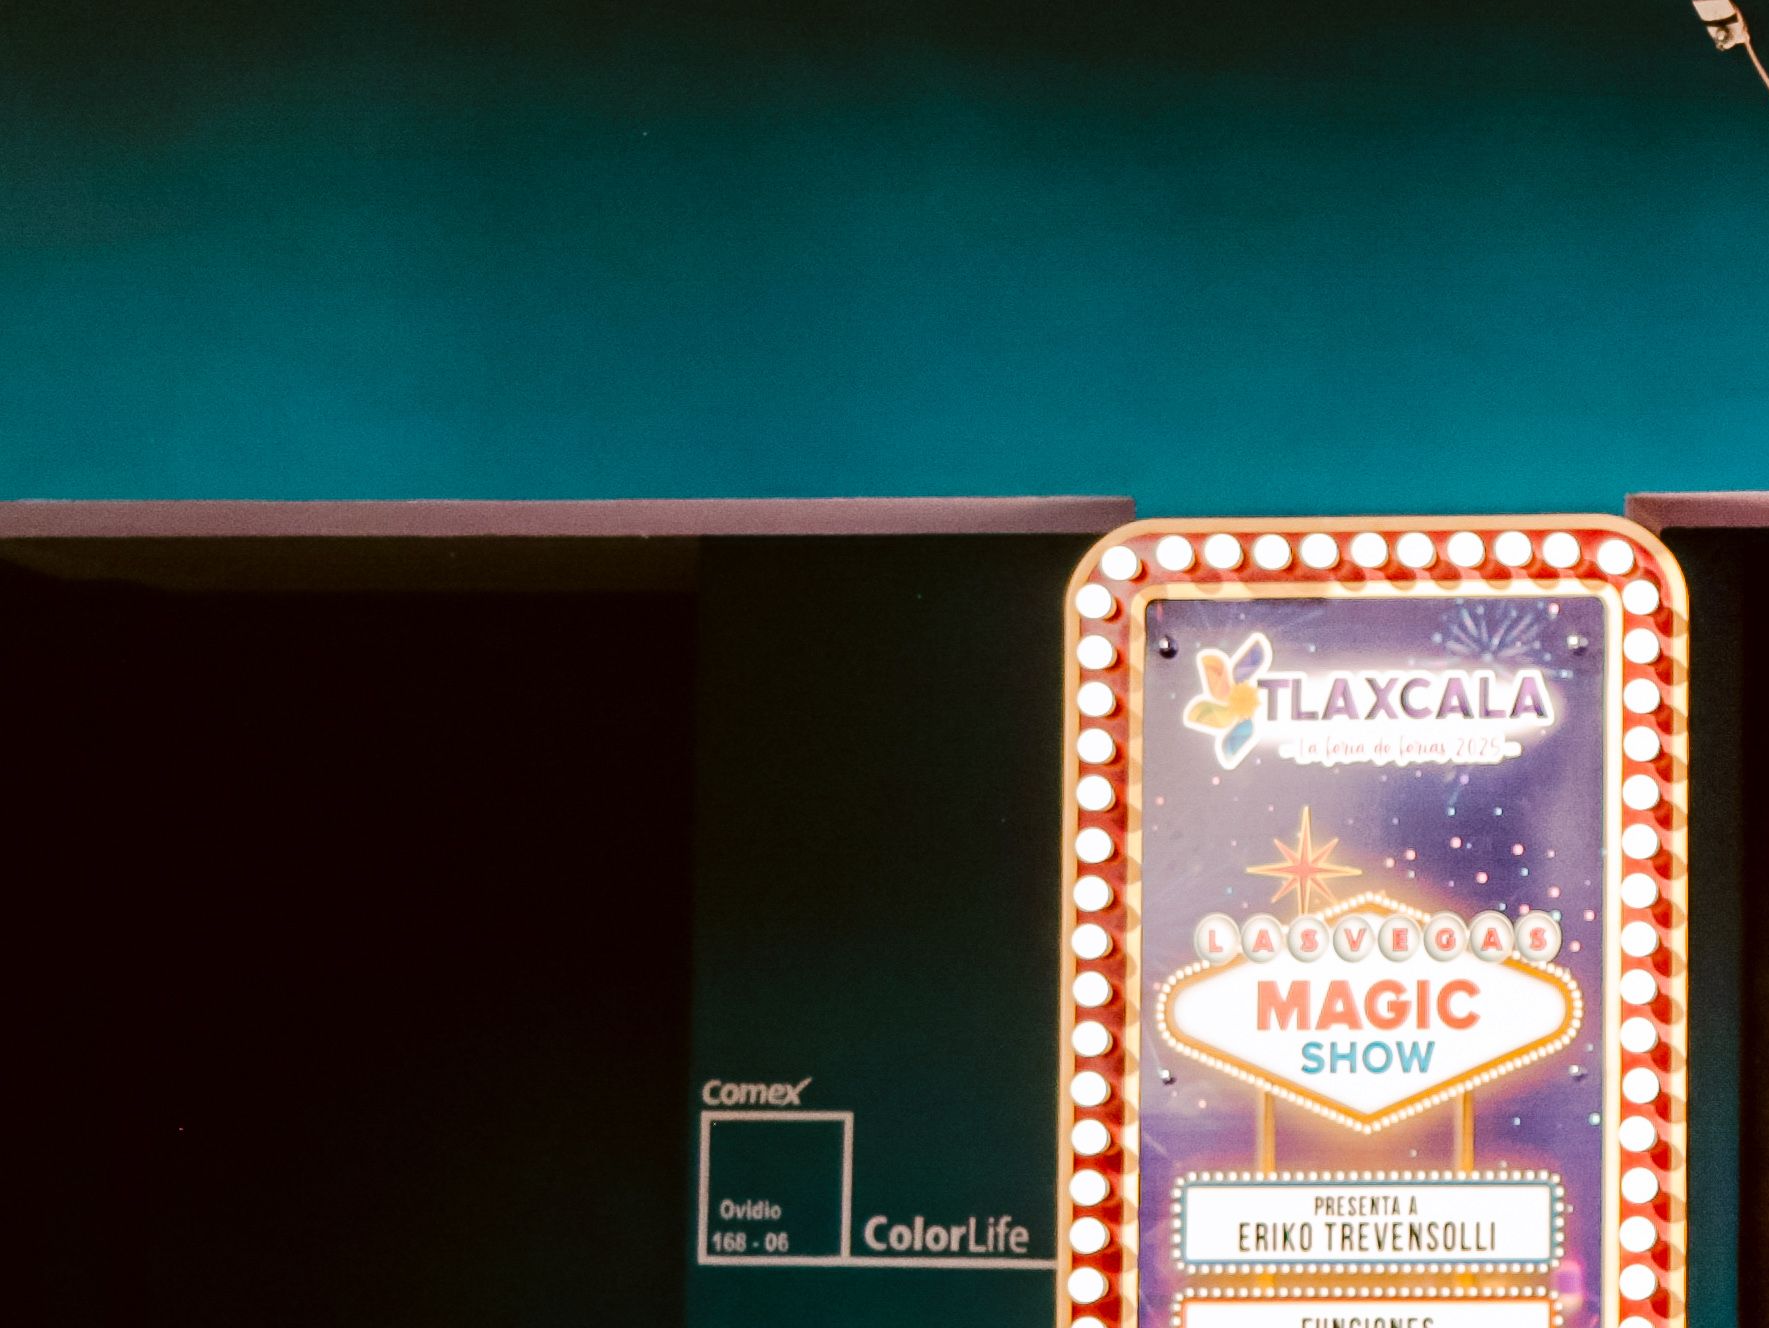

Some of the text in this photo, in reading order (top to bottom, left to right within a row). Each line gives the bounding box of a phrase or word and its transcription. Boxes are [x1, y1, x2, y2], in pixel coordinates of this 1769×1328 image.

[1257, 676, 1549, 722] TLAXCALA
[1456, 738, 1500, 756] 2025
[1256, 978, 1481, 1031] MAGIC
[1300, 1040, 1436, 1075] SHOW
[702, 1076, 812, 1106] Comex
[720, 1199, 782, 1219] Ovidio
[1313, 1194, 1418, 1218] PRESENTA A
[713, 1232, 746, 1251] 168
[765, 1232, 789, 1252] 06
[864, 1215, 1030, 1253] ColorLife
[1238, 1221, 1496, 1253] ERIKO TREVENSOLLI
